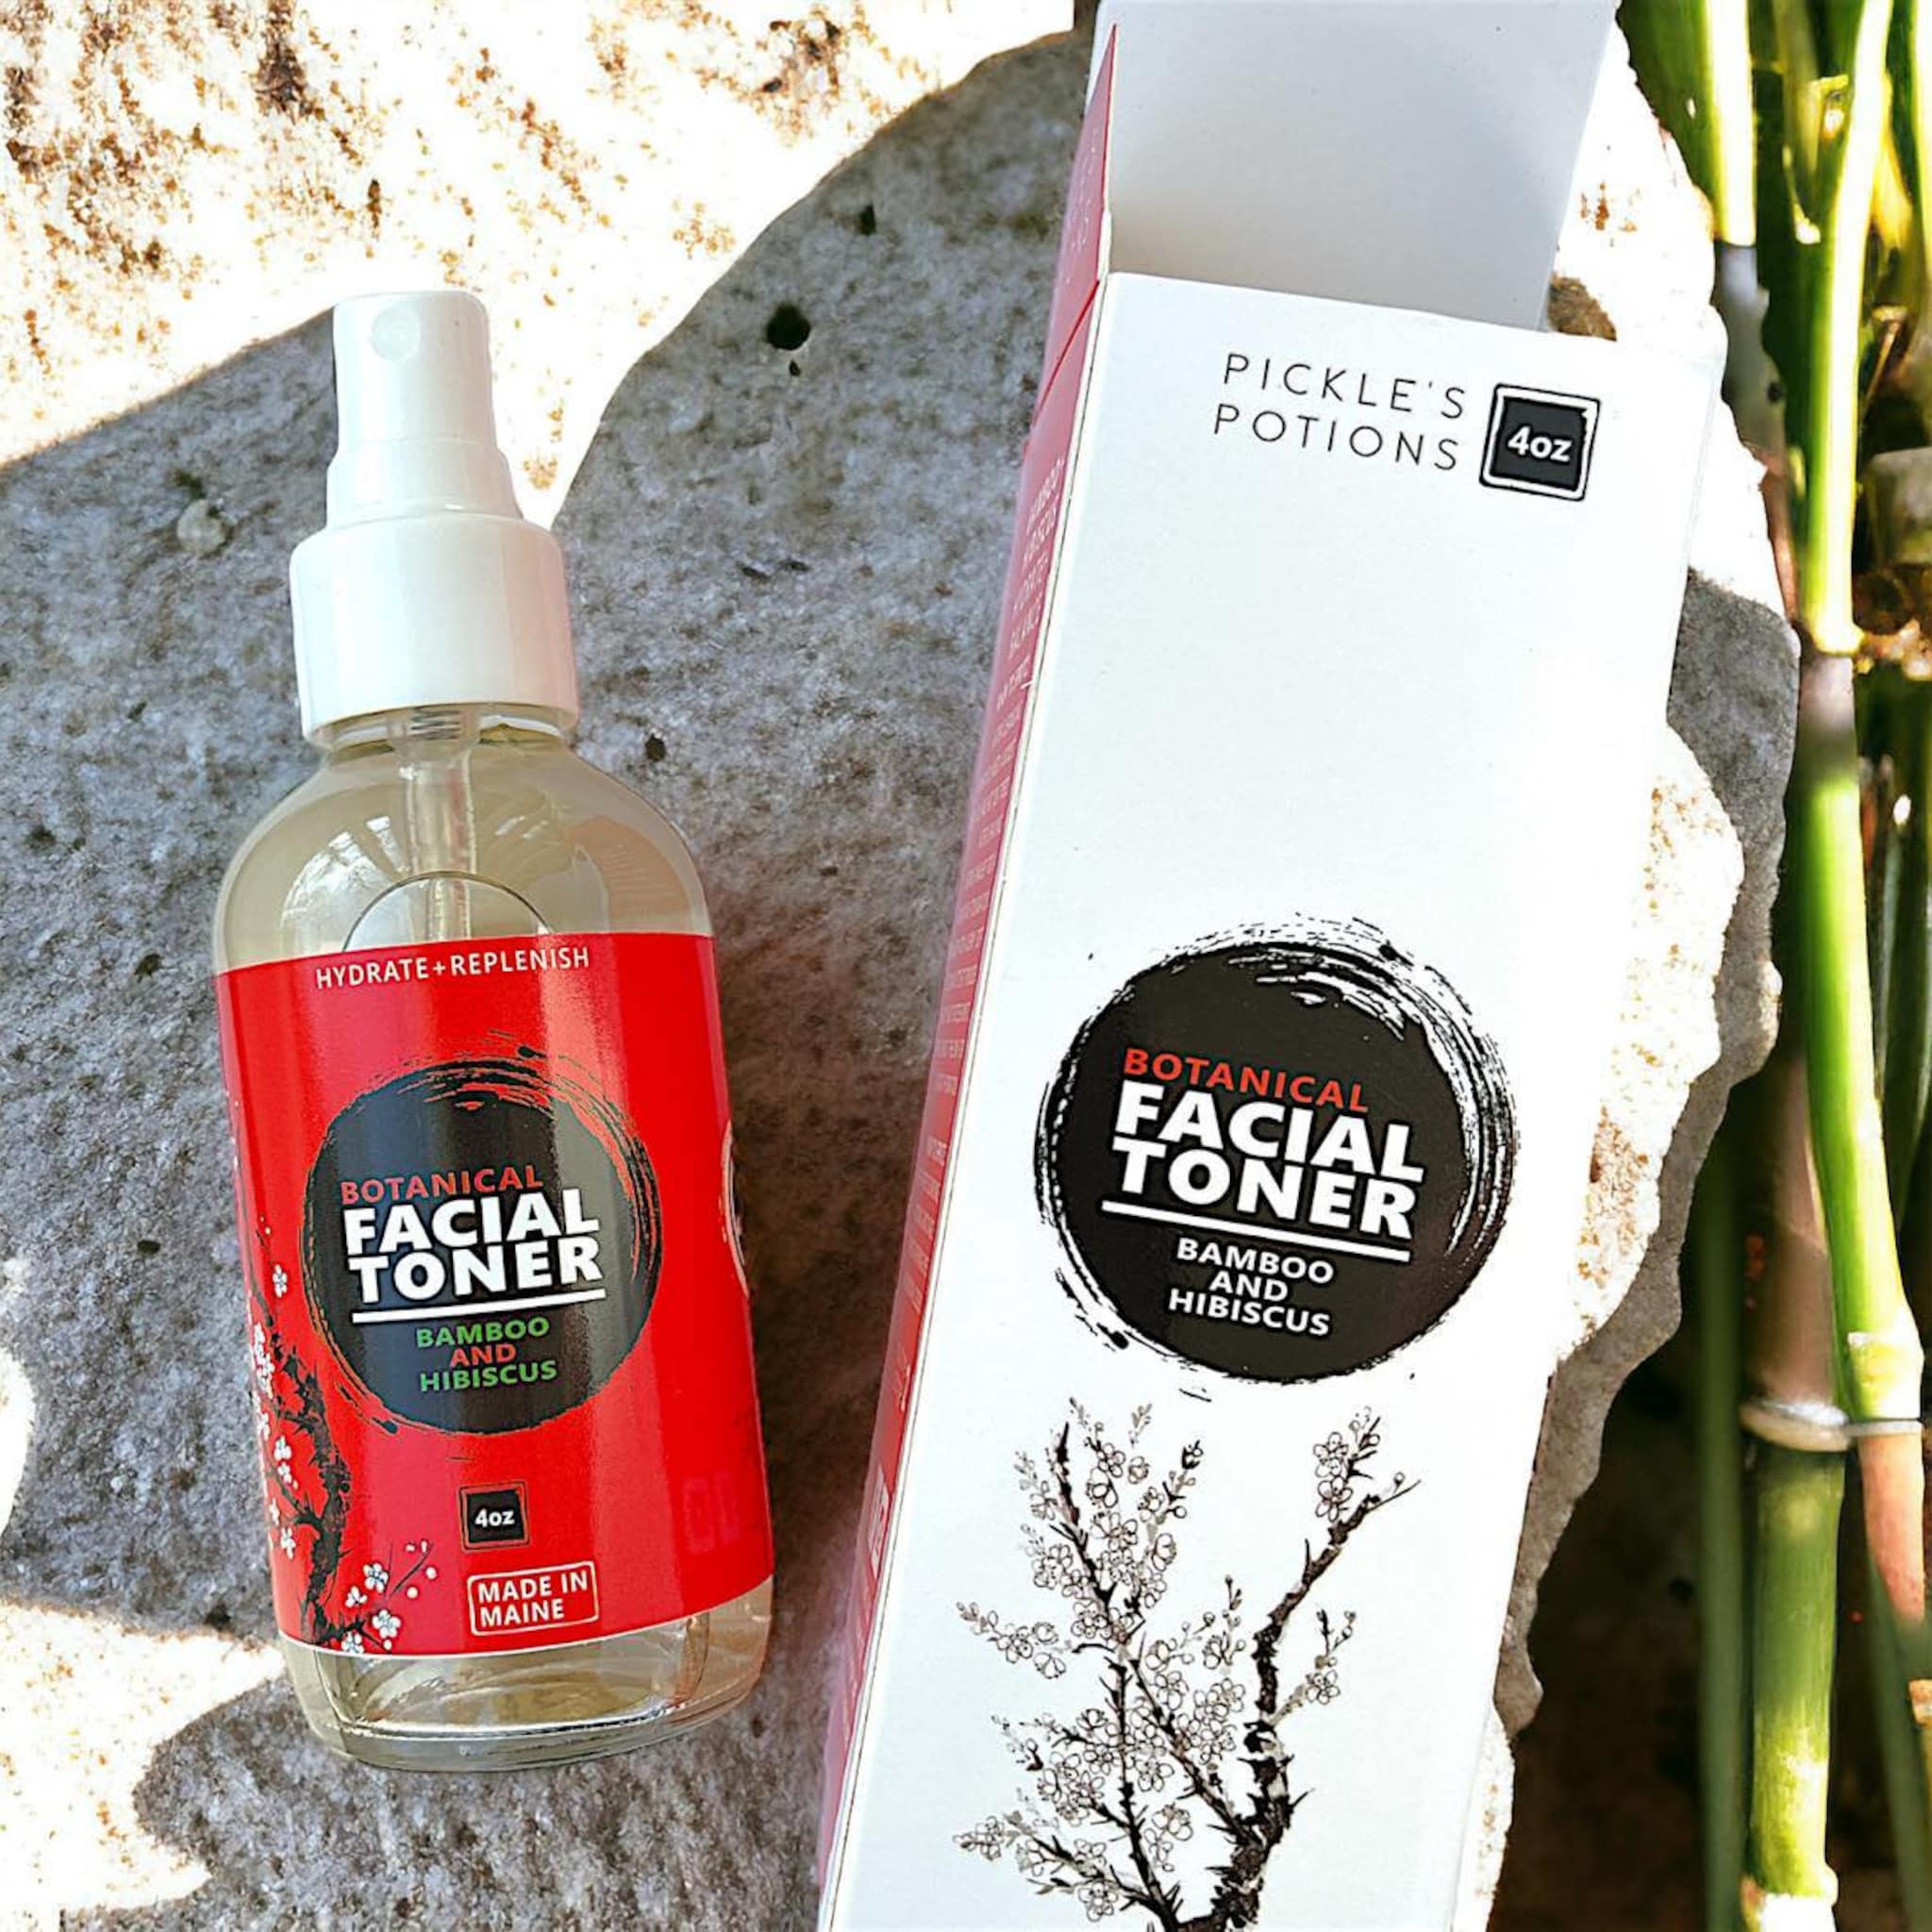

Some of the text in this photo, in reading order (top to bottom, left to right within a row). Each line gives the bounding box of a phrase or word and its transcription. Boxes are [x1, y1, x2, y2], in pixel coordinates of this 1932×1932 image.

[1224, 353, 1465, 420] PICKLE'S
[1213, 404, 1458, 471] POTIONS
[1507, 426, 1573, 464] 4oz
[1123, 1048, 1369, 1113] BOTANICAL
[1114, 1079, 1424, 1183] FACIAL
[340, 1164, 543, 1206] BOTANICAL
[1111, 1136, 1416, 1240] TONER
[342, 1188, 600, 1256] FACIAL
[347, 1235, 603, 1304] TONER
[1176, 1237, 1335, 1284] BAMBOO
[1209, 1271, 1289, 1302] AND
[416, 1316, 550, 1349] BAMBOO
[1168, 1289, 1332, 1337] HIBISCUS
[419, 1359, 558, 1392] HIBISCUS
[450, 1342, 518, 1367] AND
[475, 1507, 515, 1528] 4oz
[477, 1570, 588, 1604] MADE IN
[479, 1598, 565, 1628] MAINE
